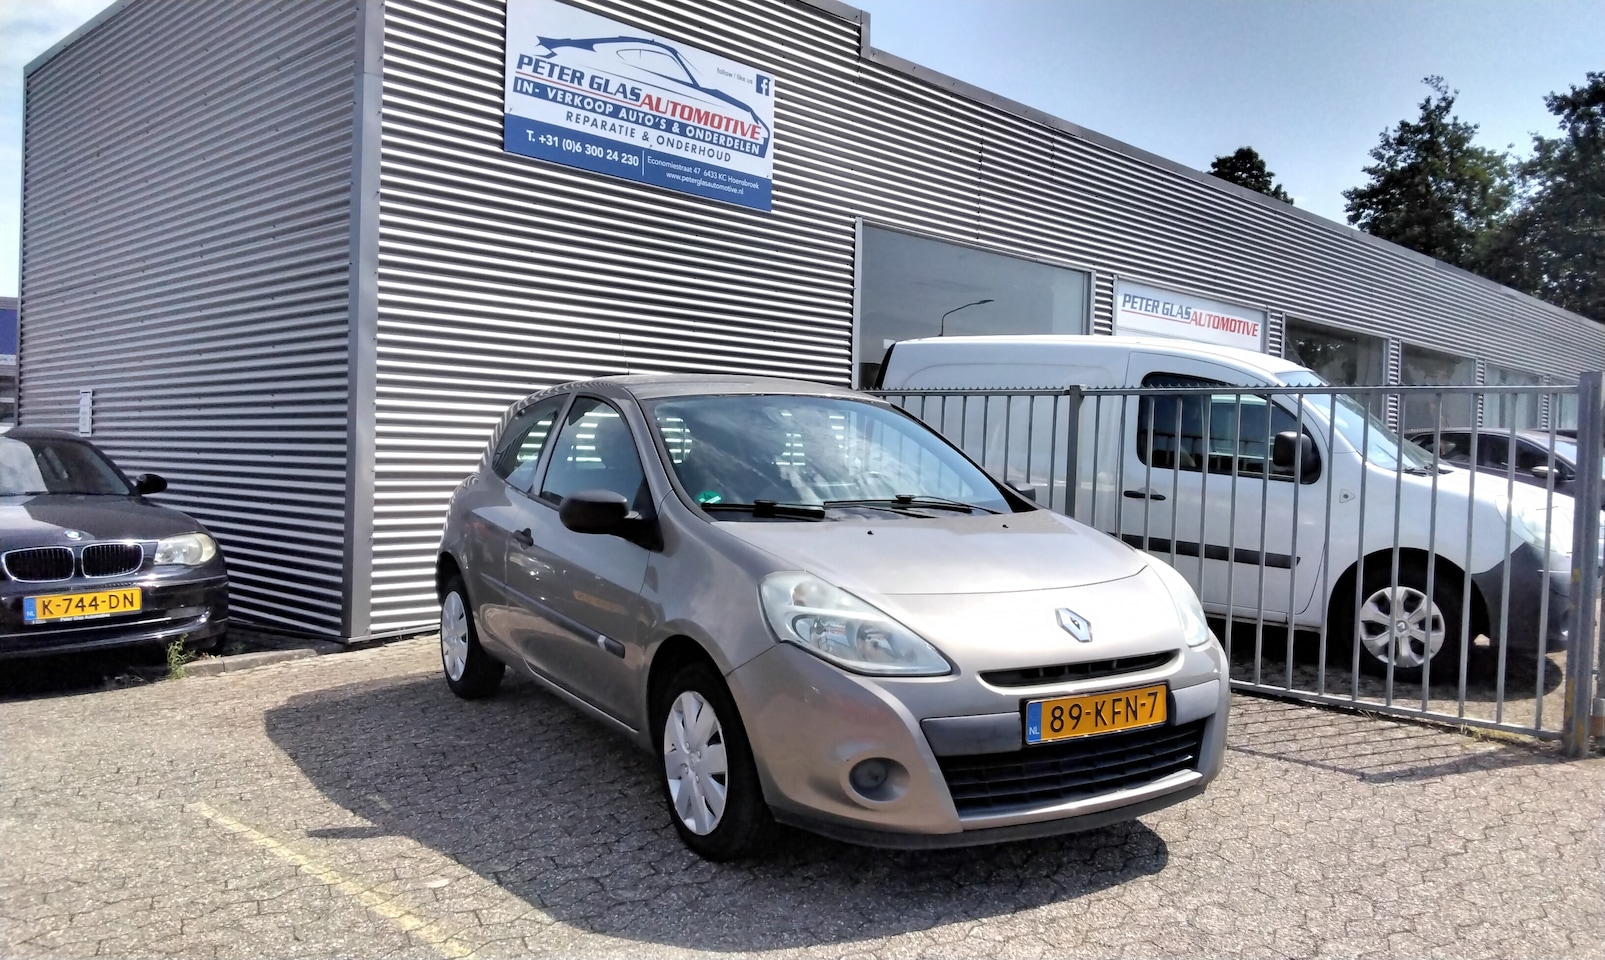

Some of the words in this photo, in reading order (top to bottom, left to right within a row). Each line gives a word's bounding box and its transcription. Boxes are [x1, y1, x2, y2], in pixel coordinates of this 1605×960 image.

[516, 53, 585, 87] PETER
[516, 78, 540, 94] IN-
[547, 87, 614, 115] VERKOOP
[618, 108, 667, 131] AUTO'S
[671, 122, 681, 134] &
[685, 126, 760, 155] ONDERDELEN
[526, 129, 536, 142] T.
[538, 134, 559, 148] +31
[562, 138, 583, 153] (0)6
[584, 143, 604, 158] 300
[606, 149, 619, 162] 24
[621, 153, 639, 167] 230
[565, 110, 636, 138] REPARATIE
[641, 131, 650, 142] &
[656, 135, 731, 162] ONDERHOUD
[647, 155, 693, 173] Economiestraat
[693, 166, 701, 175] 47
[703, 169, 718, 180] 6433
[718, 172, 727, 182] KC
[728, 175, 760, 190] Hoensbroek
[666, 171, 744, 196] www.peterglasautomotive.nl
[1122, 293, 1160, 314] PETER
[42, 592, 134, 616] K-744-DN
[1050, 691, 1159, 733] 89-KFN-7
[1028, 726, 1040, 736] NL
